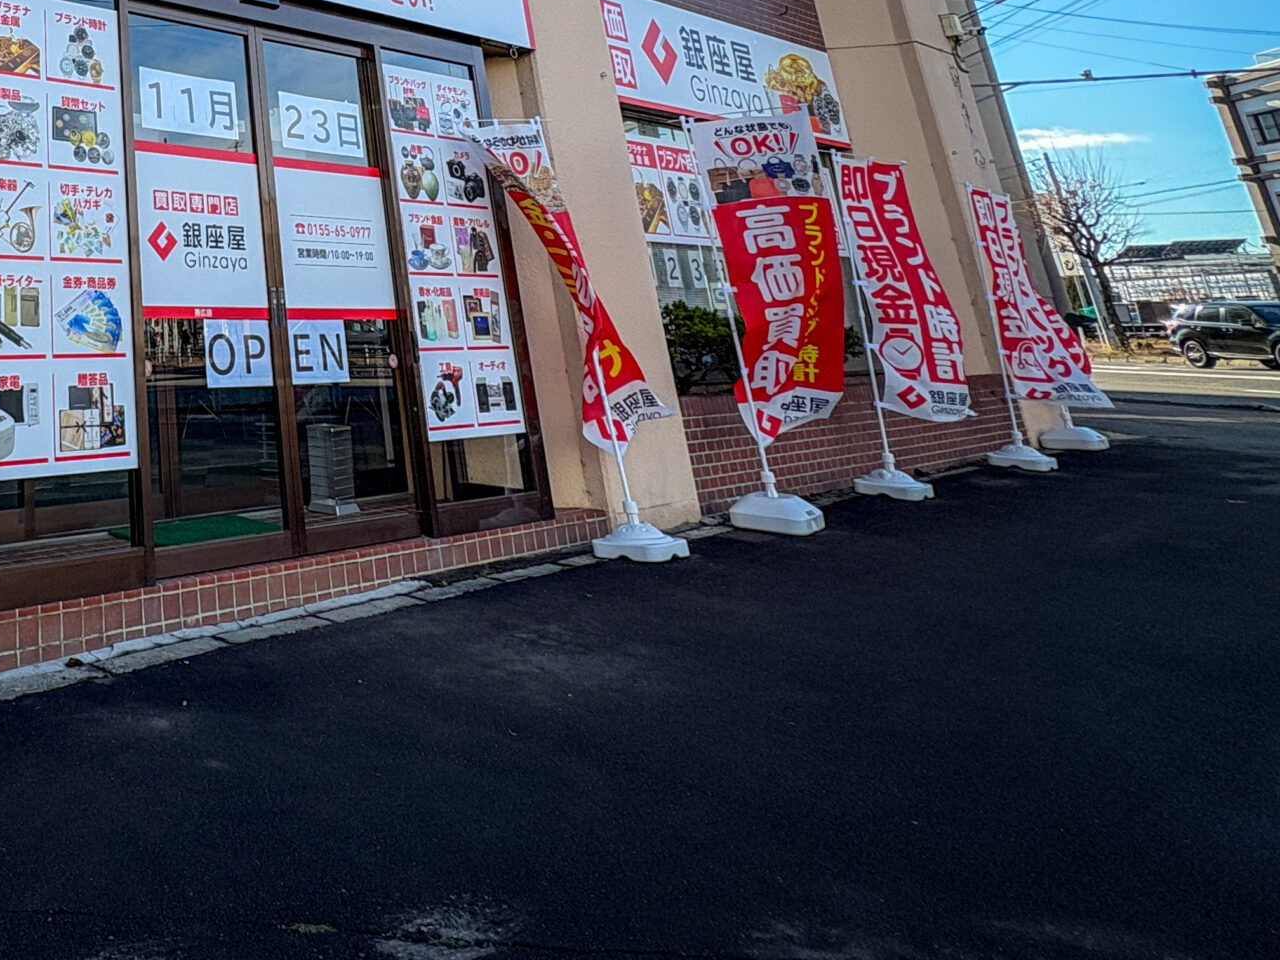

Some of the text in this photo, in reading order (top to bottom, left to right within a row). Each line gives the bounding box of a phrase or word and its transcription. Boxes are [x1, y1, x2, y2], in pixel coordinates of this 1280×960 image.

[54, 12, 108, 32] ブランド時計
[602, 1, 627, 41] 価
[610, 48, 636, 87] 取
[678, 25, 758, 84] 銀座屋
[148, 81, 235, 132] 11月
[690, 74, 764, 117] Ginzaya
[284, 104, 361, 150] 23日
[59, 183, 113, 199] 切手・テレカ
[73, 198, 102, 211] ハガキ
[153, 190, 239, 216] 買取専門店
[182, 222, 246, 251] 銀座屋
[306, 223, 371, 239] 0155-65-0977
[841, 164, 918, 327] 即日現金
[184, 251, 248, 273] Ginzaya
[873, 168, 967, 382] ブランド時計
[735, 203, 805, 395] 高価買取
